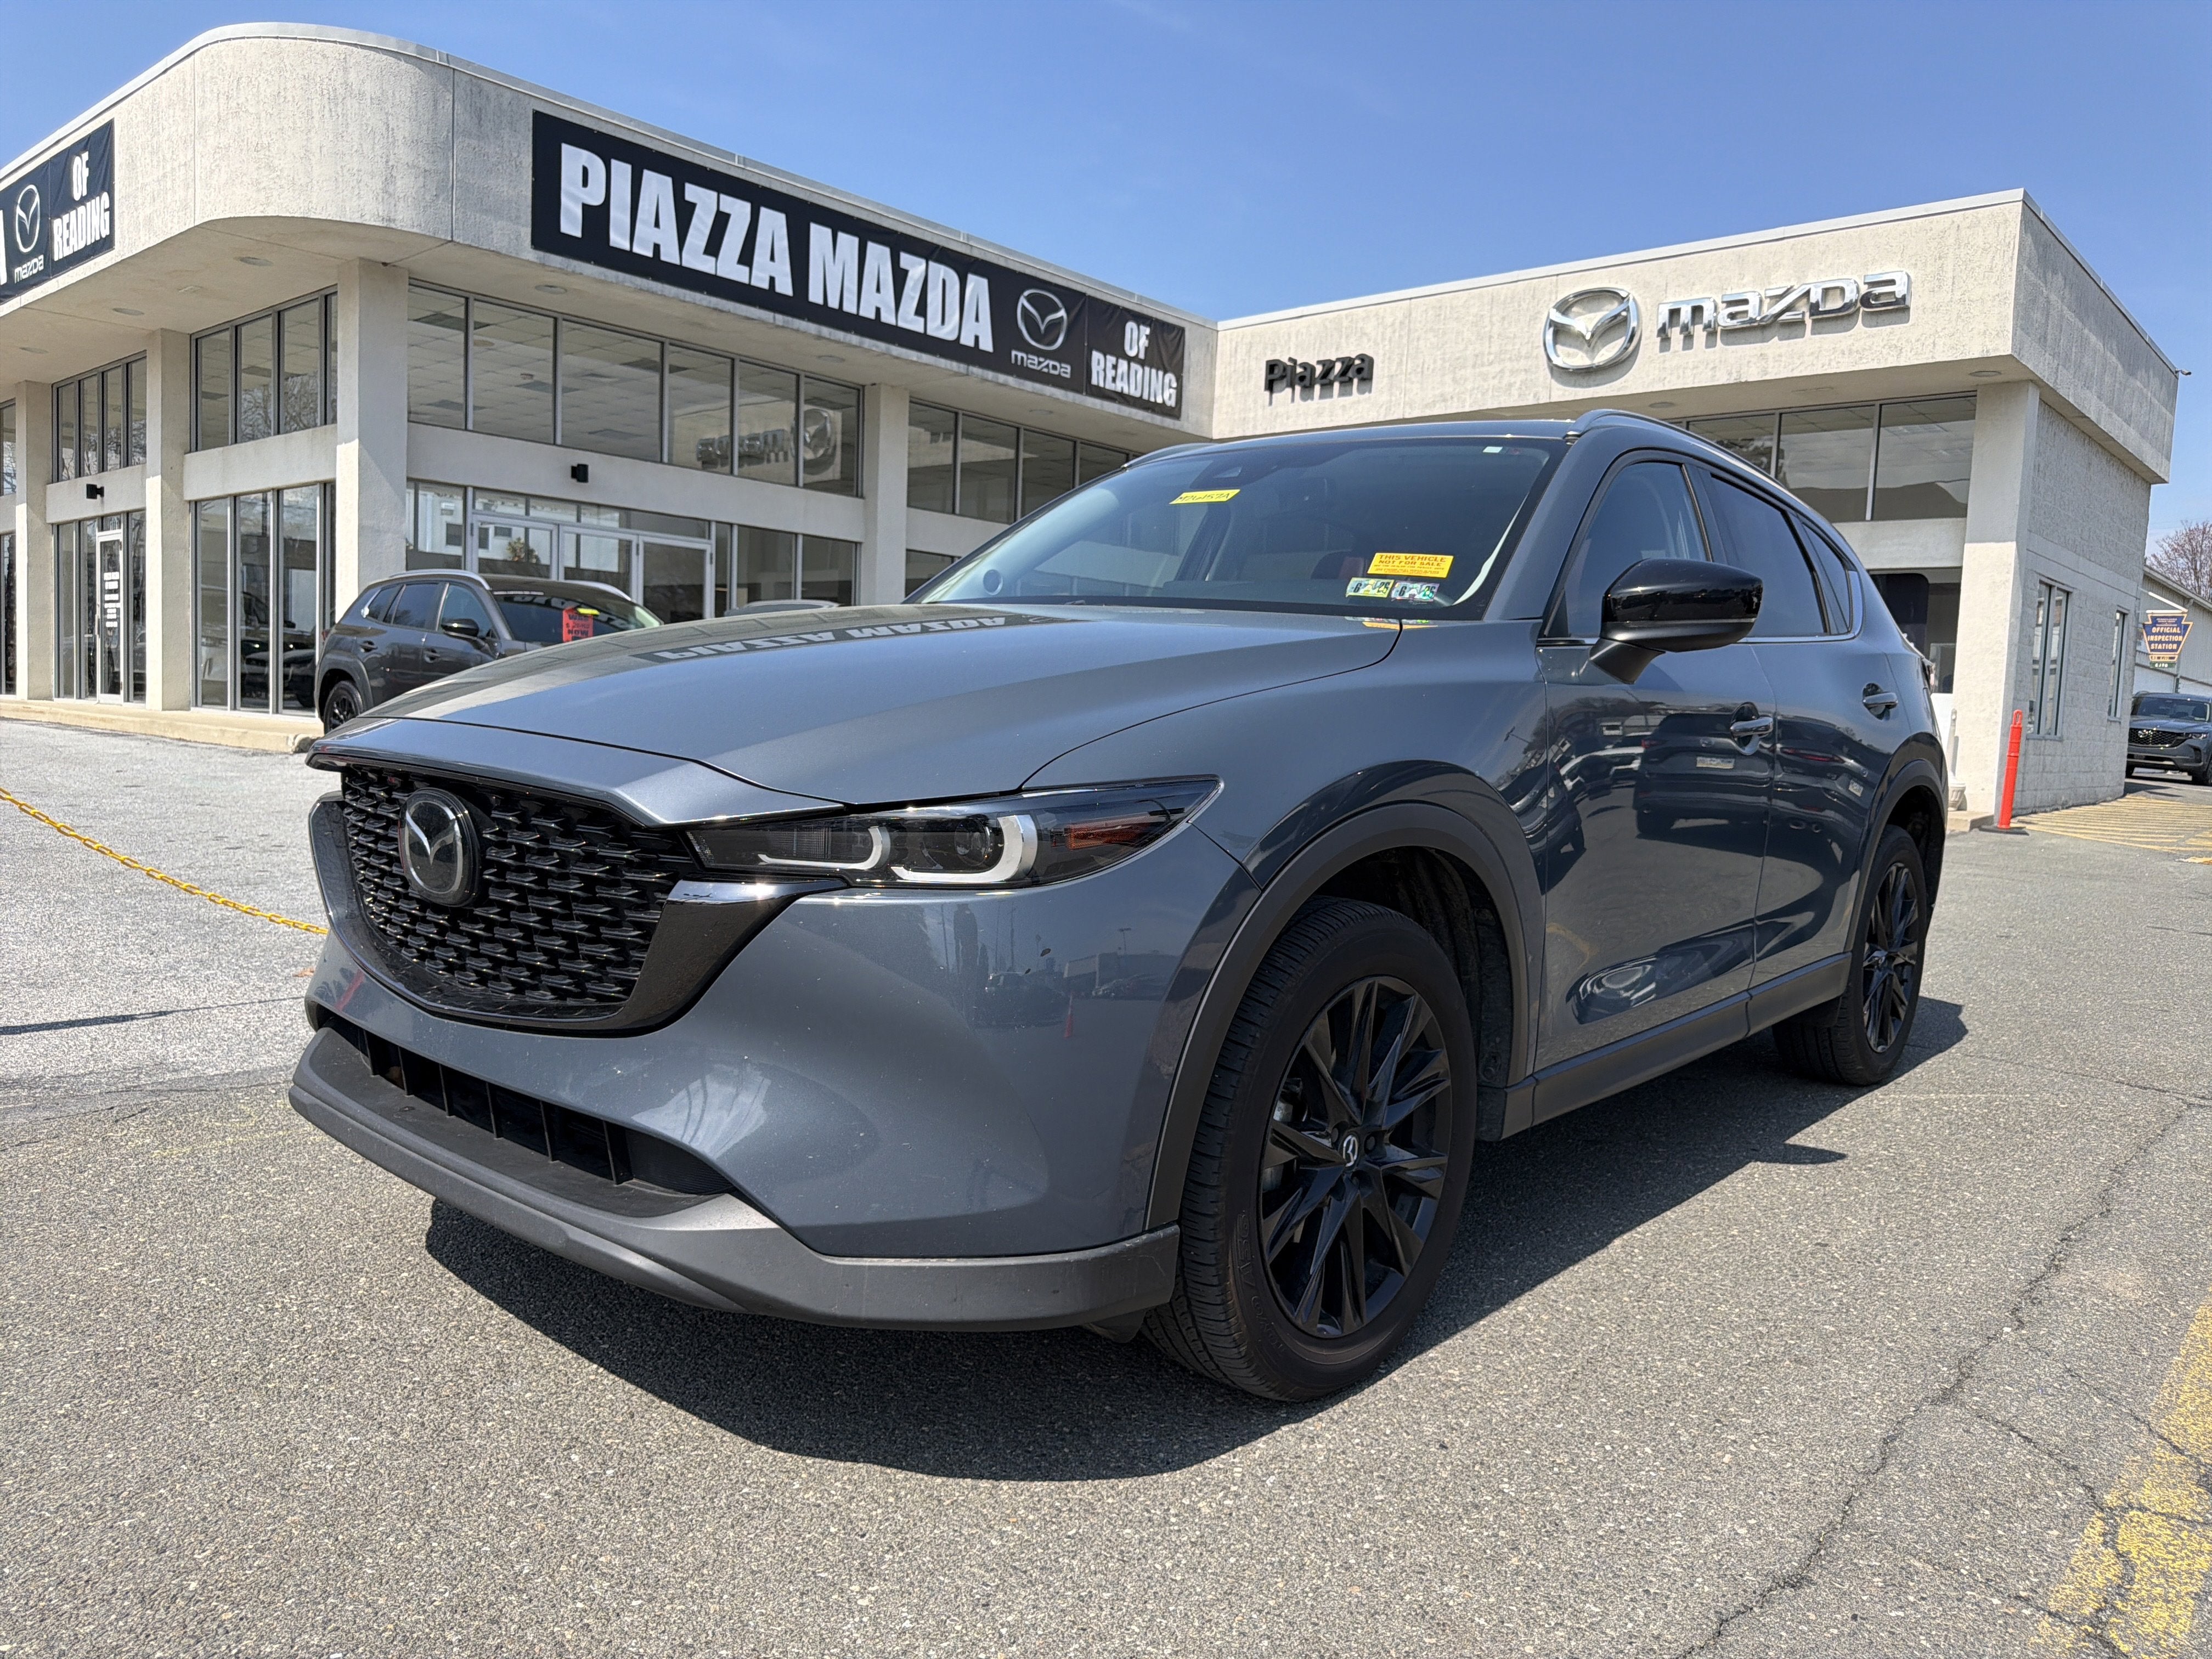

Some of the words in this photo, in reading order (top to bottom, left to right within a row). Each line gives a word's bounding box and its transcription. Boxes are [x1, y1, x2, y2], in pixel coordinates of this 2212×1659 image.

[72, 150, 89, 201] OF
[53, 191, 110, 262] READING
[560, 143, 793, 297] PIAZZA
[808, 222, 994, 353] MAZDA
[1124, 320, 1151, 360] OF
[1091, 349, 1177, 408] READING
[1264, 353, 1374, 392] Piazza
